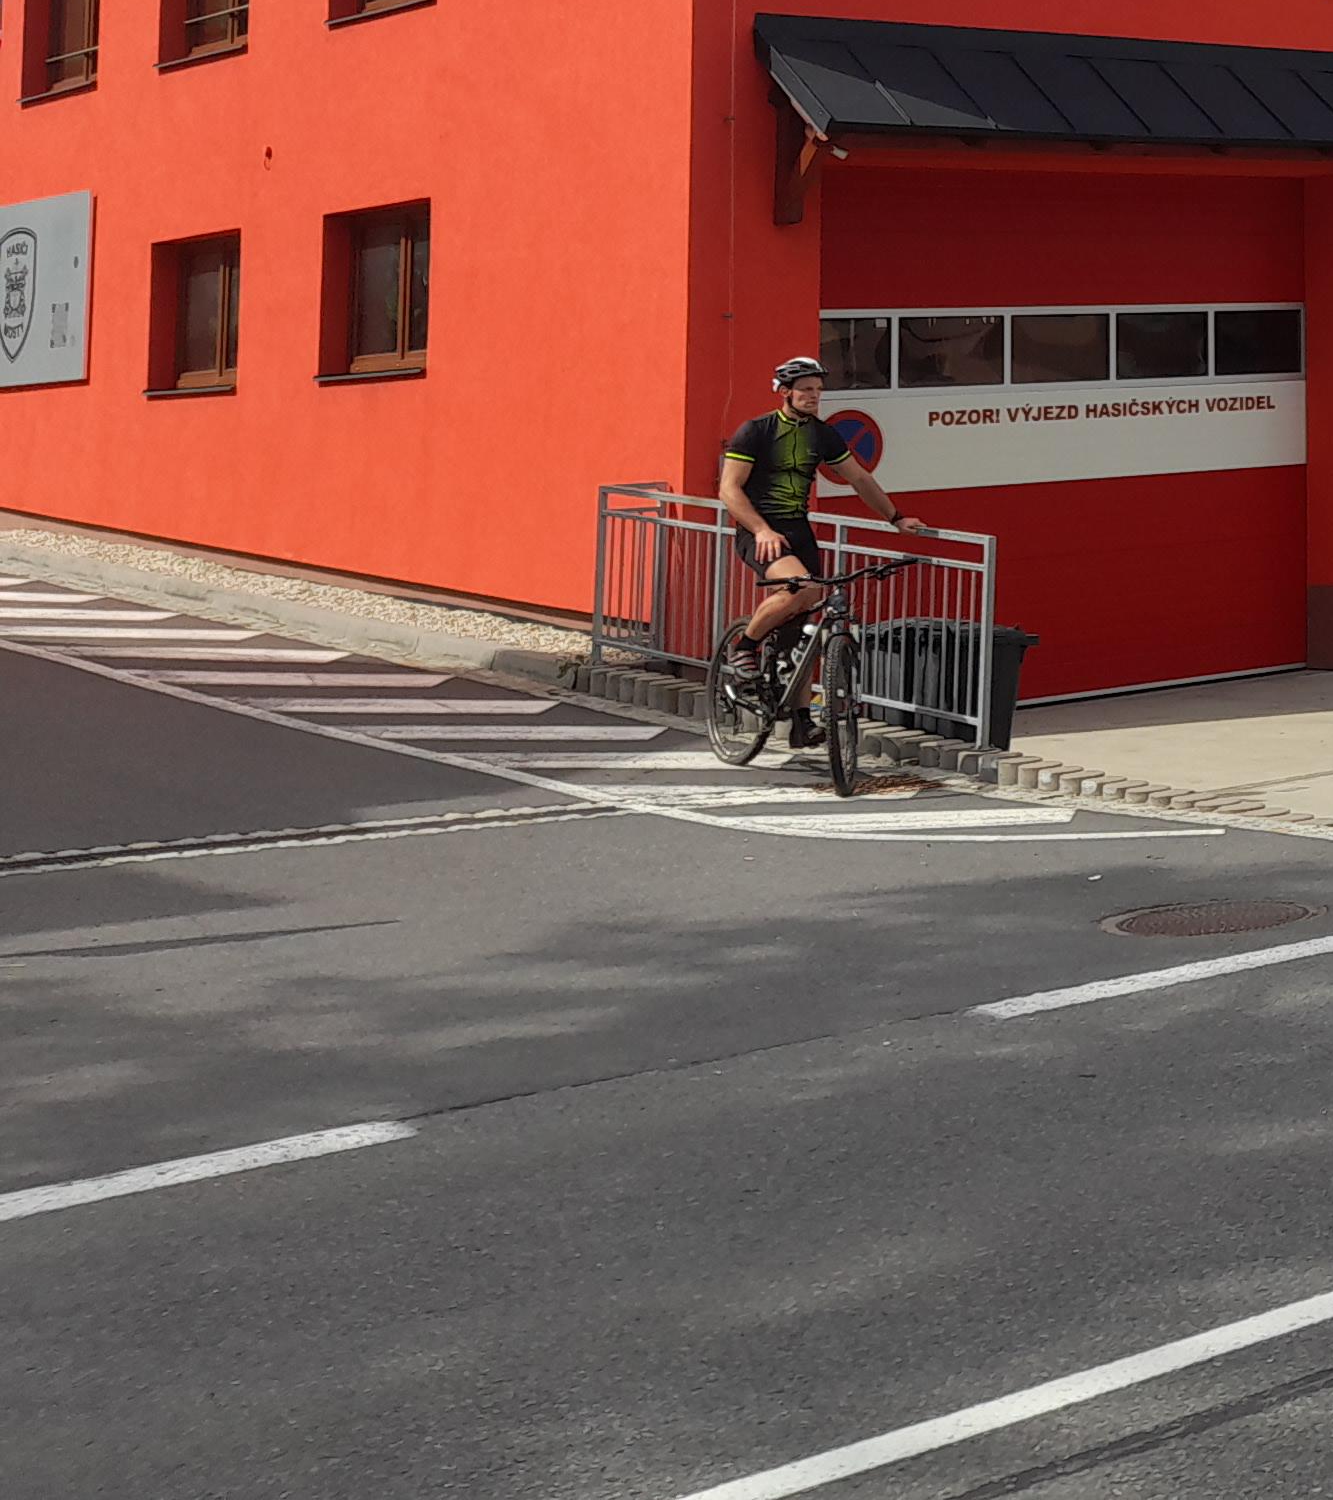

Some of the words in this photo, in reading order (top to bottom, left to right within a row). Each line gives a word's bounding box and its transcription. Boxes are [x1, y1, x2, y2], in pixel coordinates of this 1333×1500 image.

[928, 406, 1001, 427] POZOR!
[1007, 398, 1079, 424] VÝJEZD
[1085, 394, 1200, 420] HASIČSKÝCH
[1205, 395, 1276, 413] VOZIDEL
